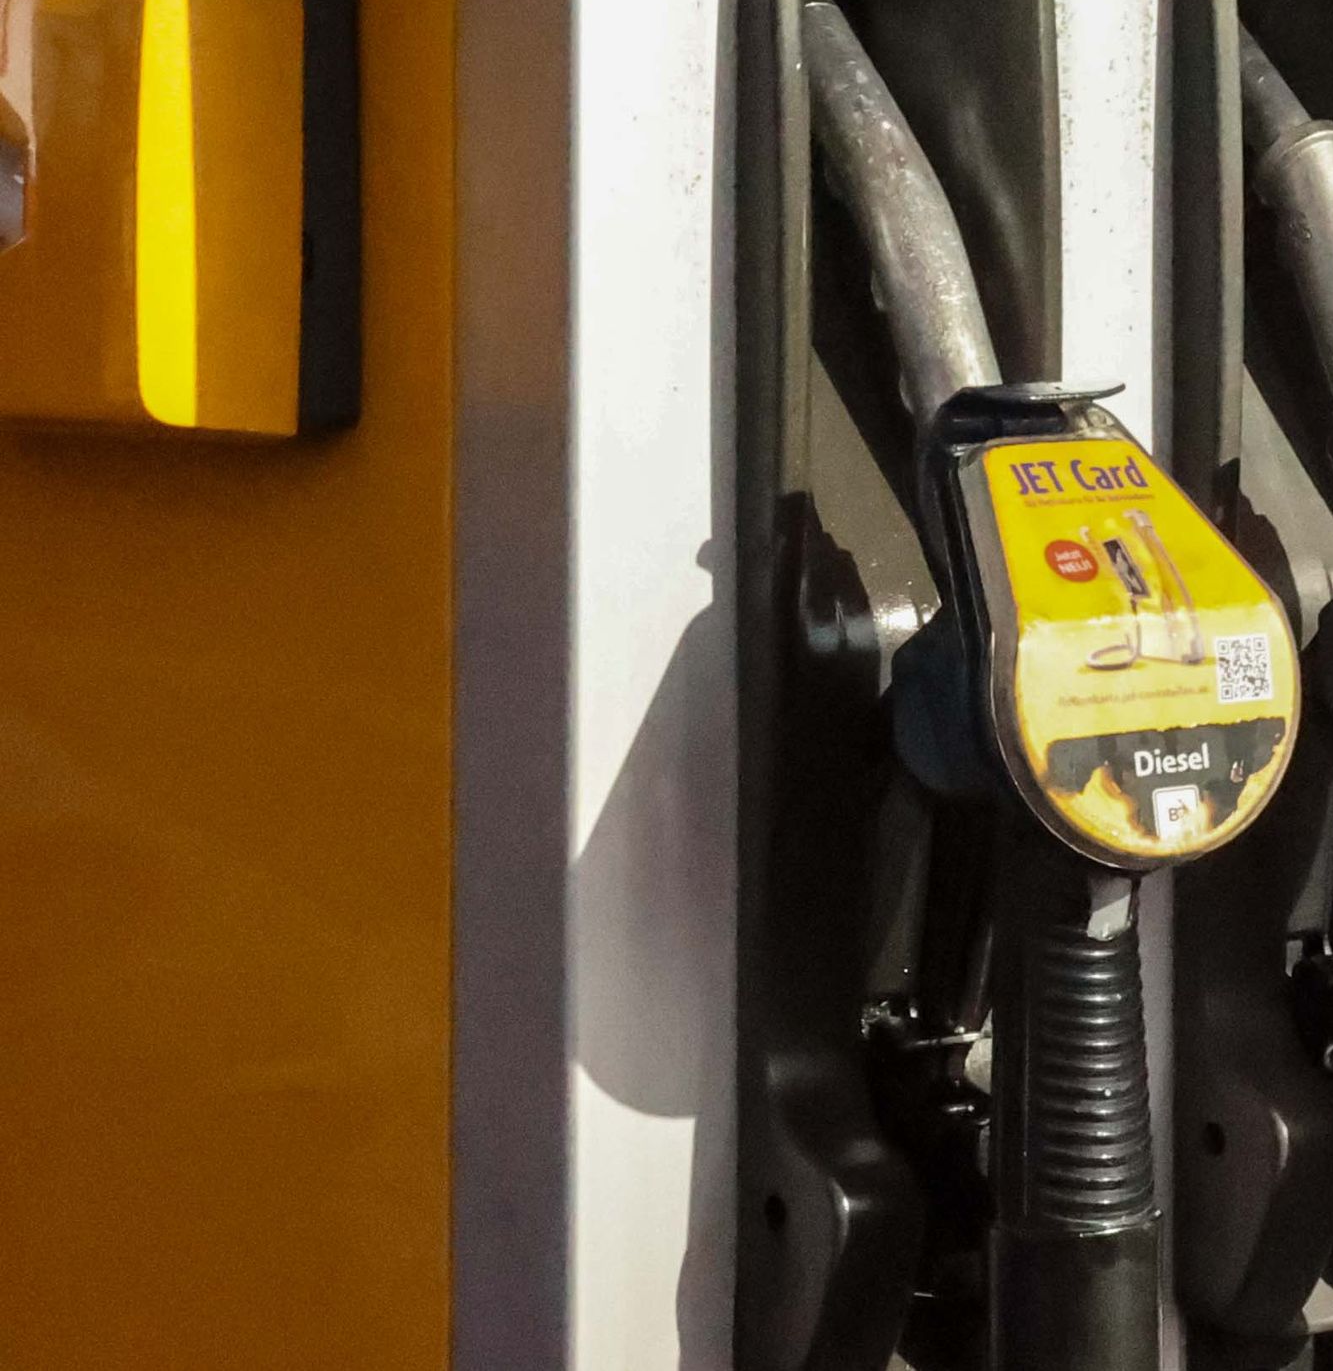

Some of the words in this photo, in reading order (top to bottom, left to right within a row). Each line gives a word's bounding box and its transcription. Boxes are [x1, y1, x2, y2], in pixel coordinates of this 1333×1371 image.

[1010, 461, 1064, 495] JET
[1070, 456, 1148, 491] Card
[1134, 742, 1210, 777] Diesel
